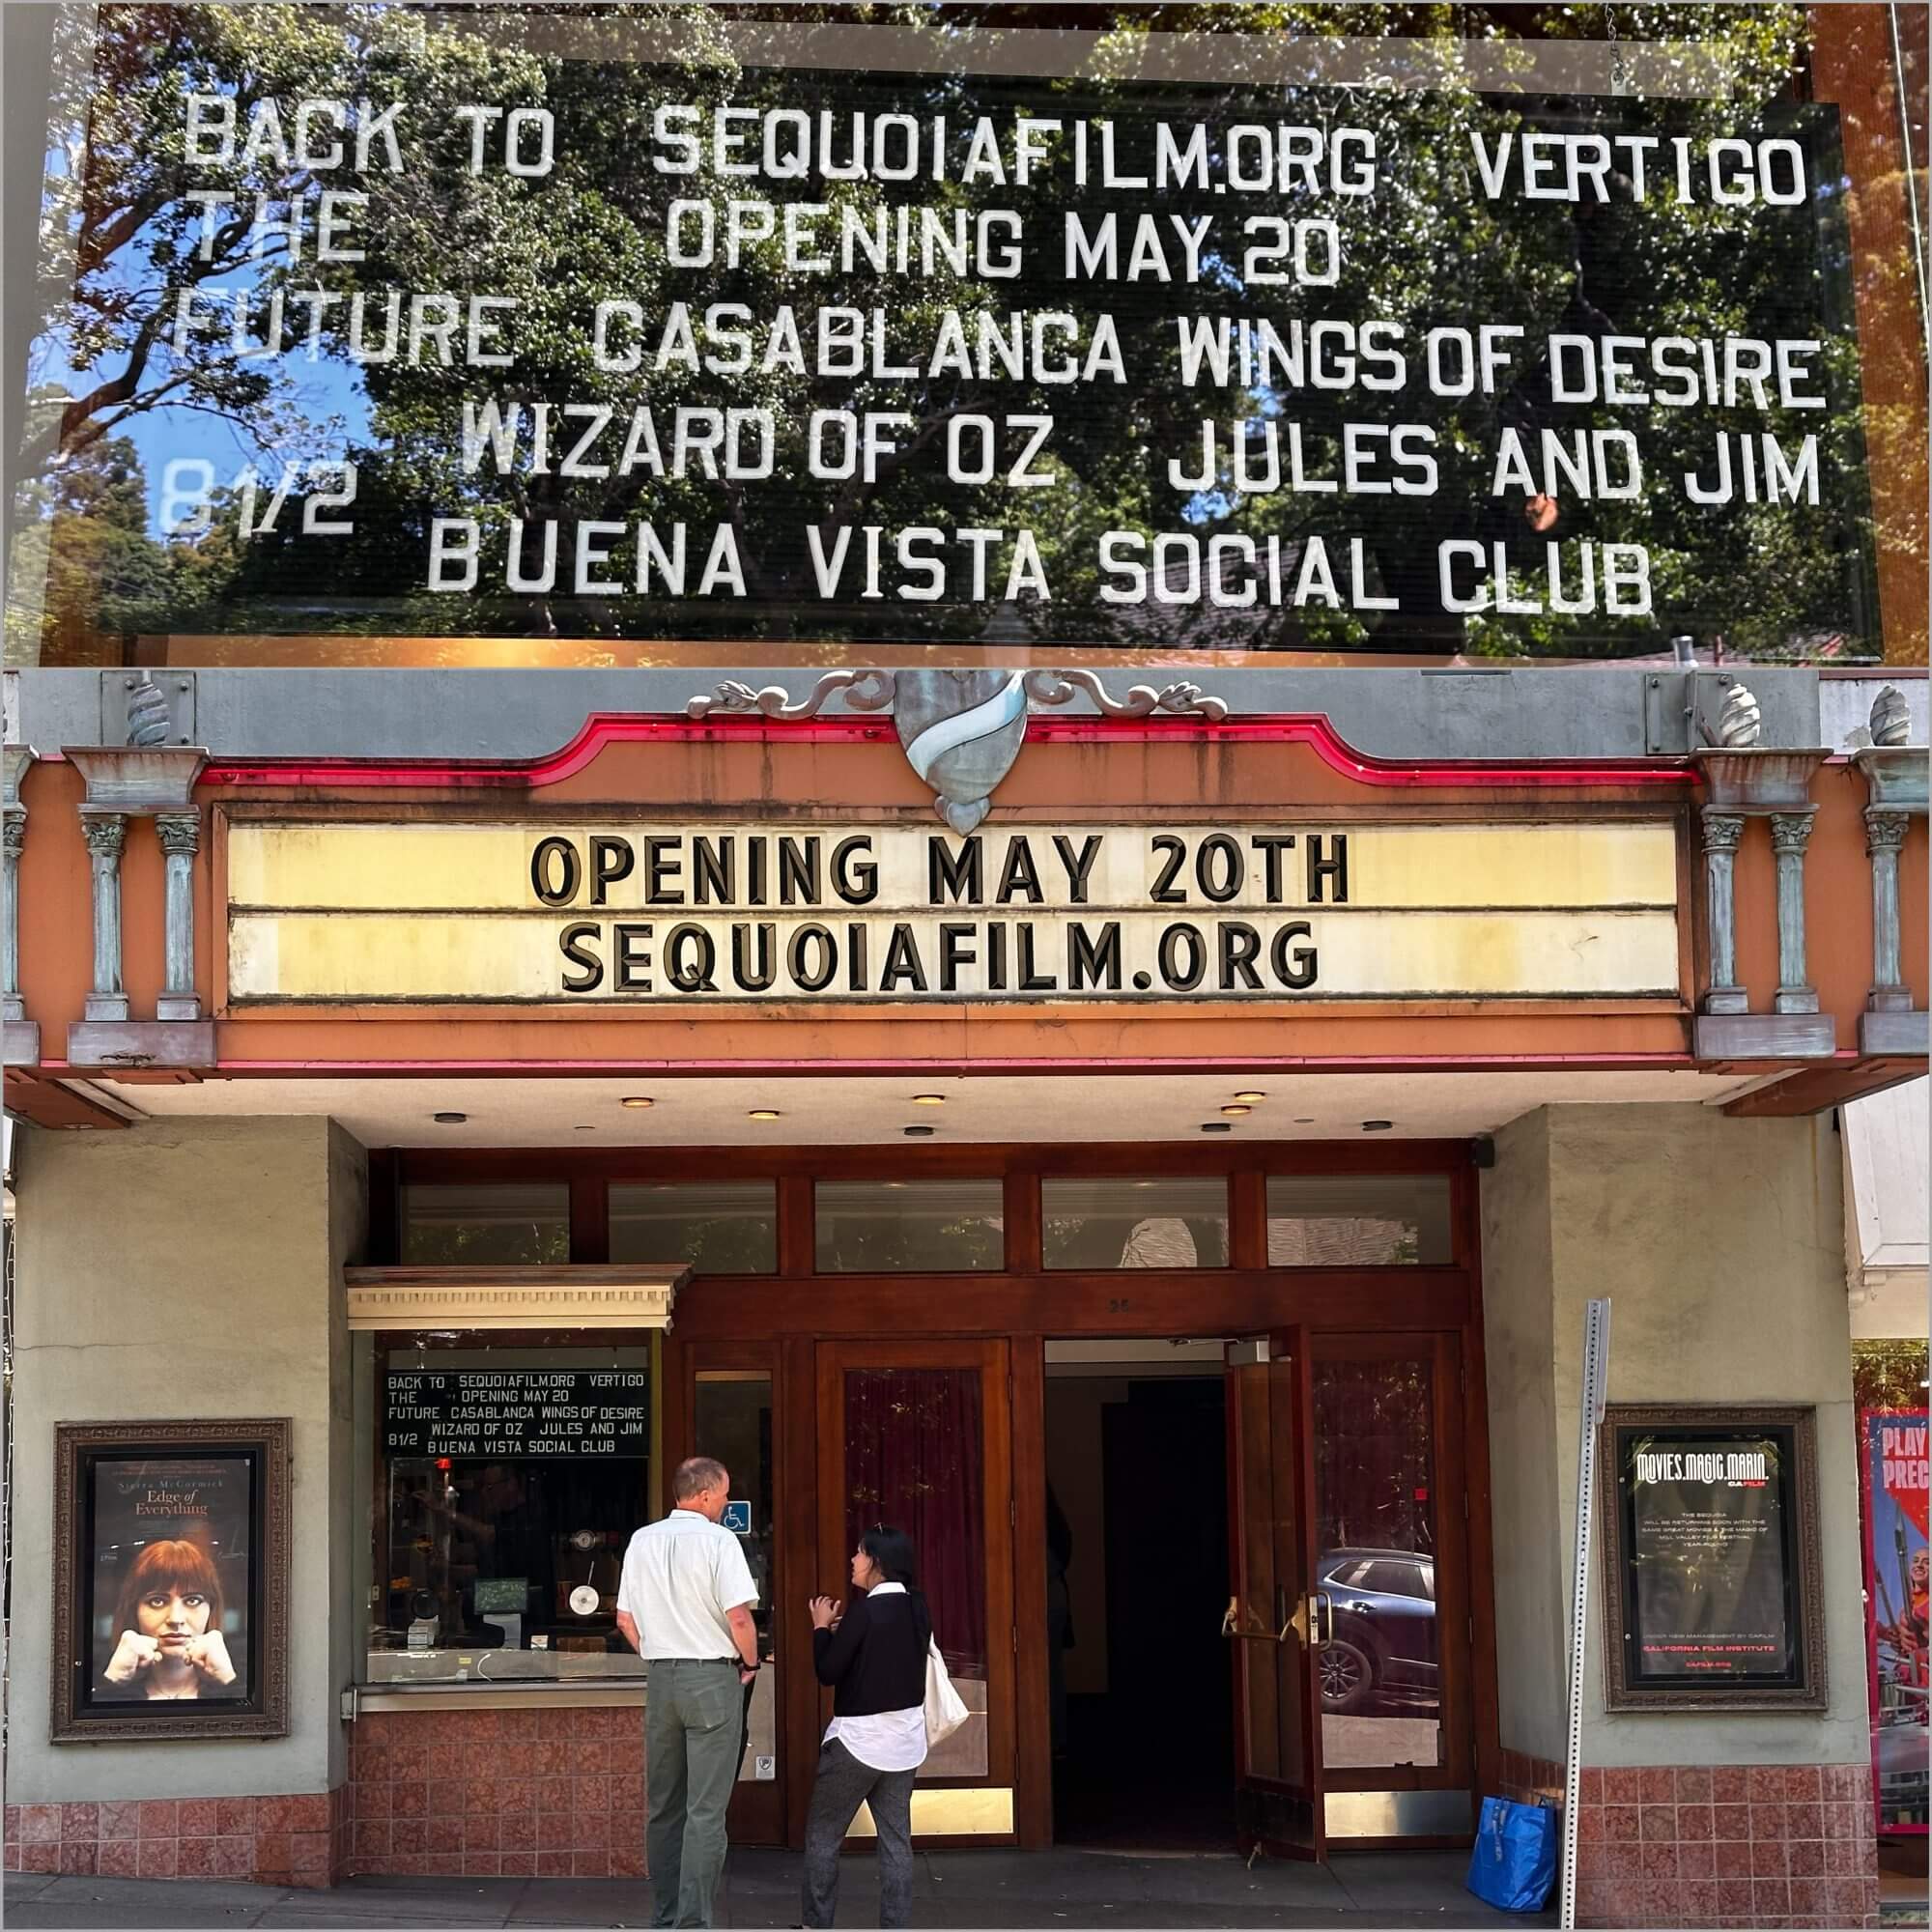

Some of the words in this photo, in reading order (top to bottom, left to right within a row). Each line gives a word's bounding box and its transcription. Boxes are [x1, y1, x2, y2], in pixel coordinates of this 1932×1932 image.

[185, 93, 406, 174] BACK
[458, 105, 555, 178] TO
[652, 102, 1377, 197] SEQUOIAFILM.ORG
[1470, 131, 1806, 206] VERTIGO
[185, 189, 370, 264] THE
[668, 199, 1023, 280] OPENING
[1066, 212, 1213, 283] MAY
[1243, 216, 1341, 286] 20
[170, 287, 517, 368] FUTURE
[594, 300, 1127, 384] CASABLANCA
[1179, 316, 1406, 391] WINGS
[1428, 325, 1524, 397] OF
[1551, 334, 1827, 411] DESIRE
[462, 401, 776, 480] WIZARD
[809, 410, 912, 483] OF
[947, 414, 1056, 487] OZ
[1169, 419, 1438, 495] JULES
[1492, 428, 1640, 500] AND
[1685, 432, 1820, 506] JIM
[428, 519, 746, 597] BUENA
[809, 526, 1050, 602] VISTA
[1100, 530, 1399, 610] SOCIAL
[1439, 538, 1652, 615] CLUB
[530, 836, 879, 906] OPENING
[928, 835, 1103, 904] MAY
[1150, 833, 1349, 903] 20TH
[559, 922, 1318, 992] SEQUOIAFILM.ORG
[388, 1377, 422, 1389] BACK
[428, 1377, 444, 1388] TO
[459, 1375, 575, 1387] SEQUOIAFILM.ORG
[589, 1375, 644, 1386] VERTIGO
[389, 1391, 417, 1404] THE
[461, 1390, 519, 1403] OPENING
[524, 1390, 549, 1403] MAY
[553, 1390, 569, 1402] 20
[388, 1406, 440, 1419] FUTURE
[451, 1406, 534, 1418] CASABLANCA
[542, 1406, 579, 1418] WINGS
[582, 1406, 596, 1418] OF
[601, 1407, 644, 1419] DESIRE
[432, 1423, 480, 1435] WIZARD
[484, 1423, 501, 1435] OF
[505, 1423, 523, 1435] OZ
[540, 1423, 583, 1435] JULES
[590, 1423, 614, 1435] AND
[620, 1422, 642, 1435] JIM
[1883, 1428, 1926, 1456] PLAY
[428, 1441, 475, 1454] BUENA
[484, 1440, 522, 1453] VISTA
[528, 1440, 575, 1453] SOCIAL
[582, 1440, 615, 1453] CLUB
[136, 1503, 209, 1518] Everything
[148, 1491, 181, 1505] Edge
[184, 1490, 198, 1505] of
